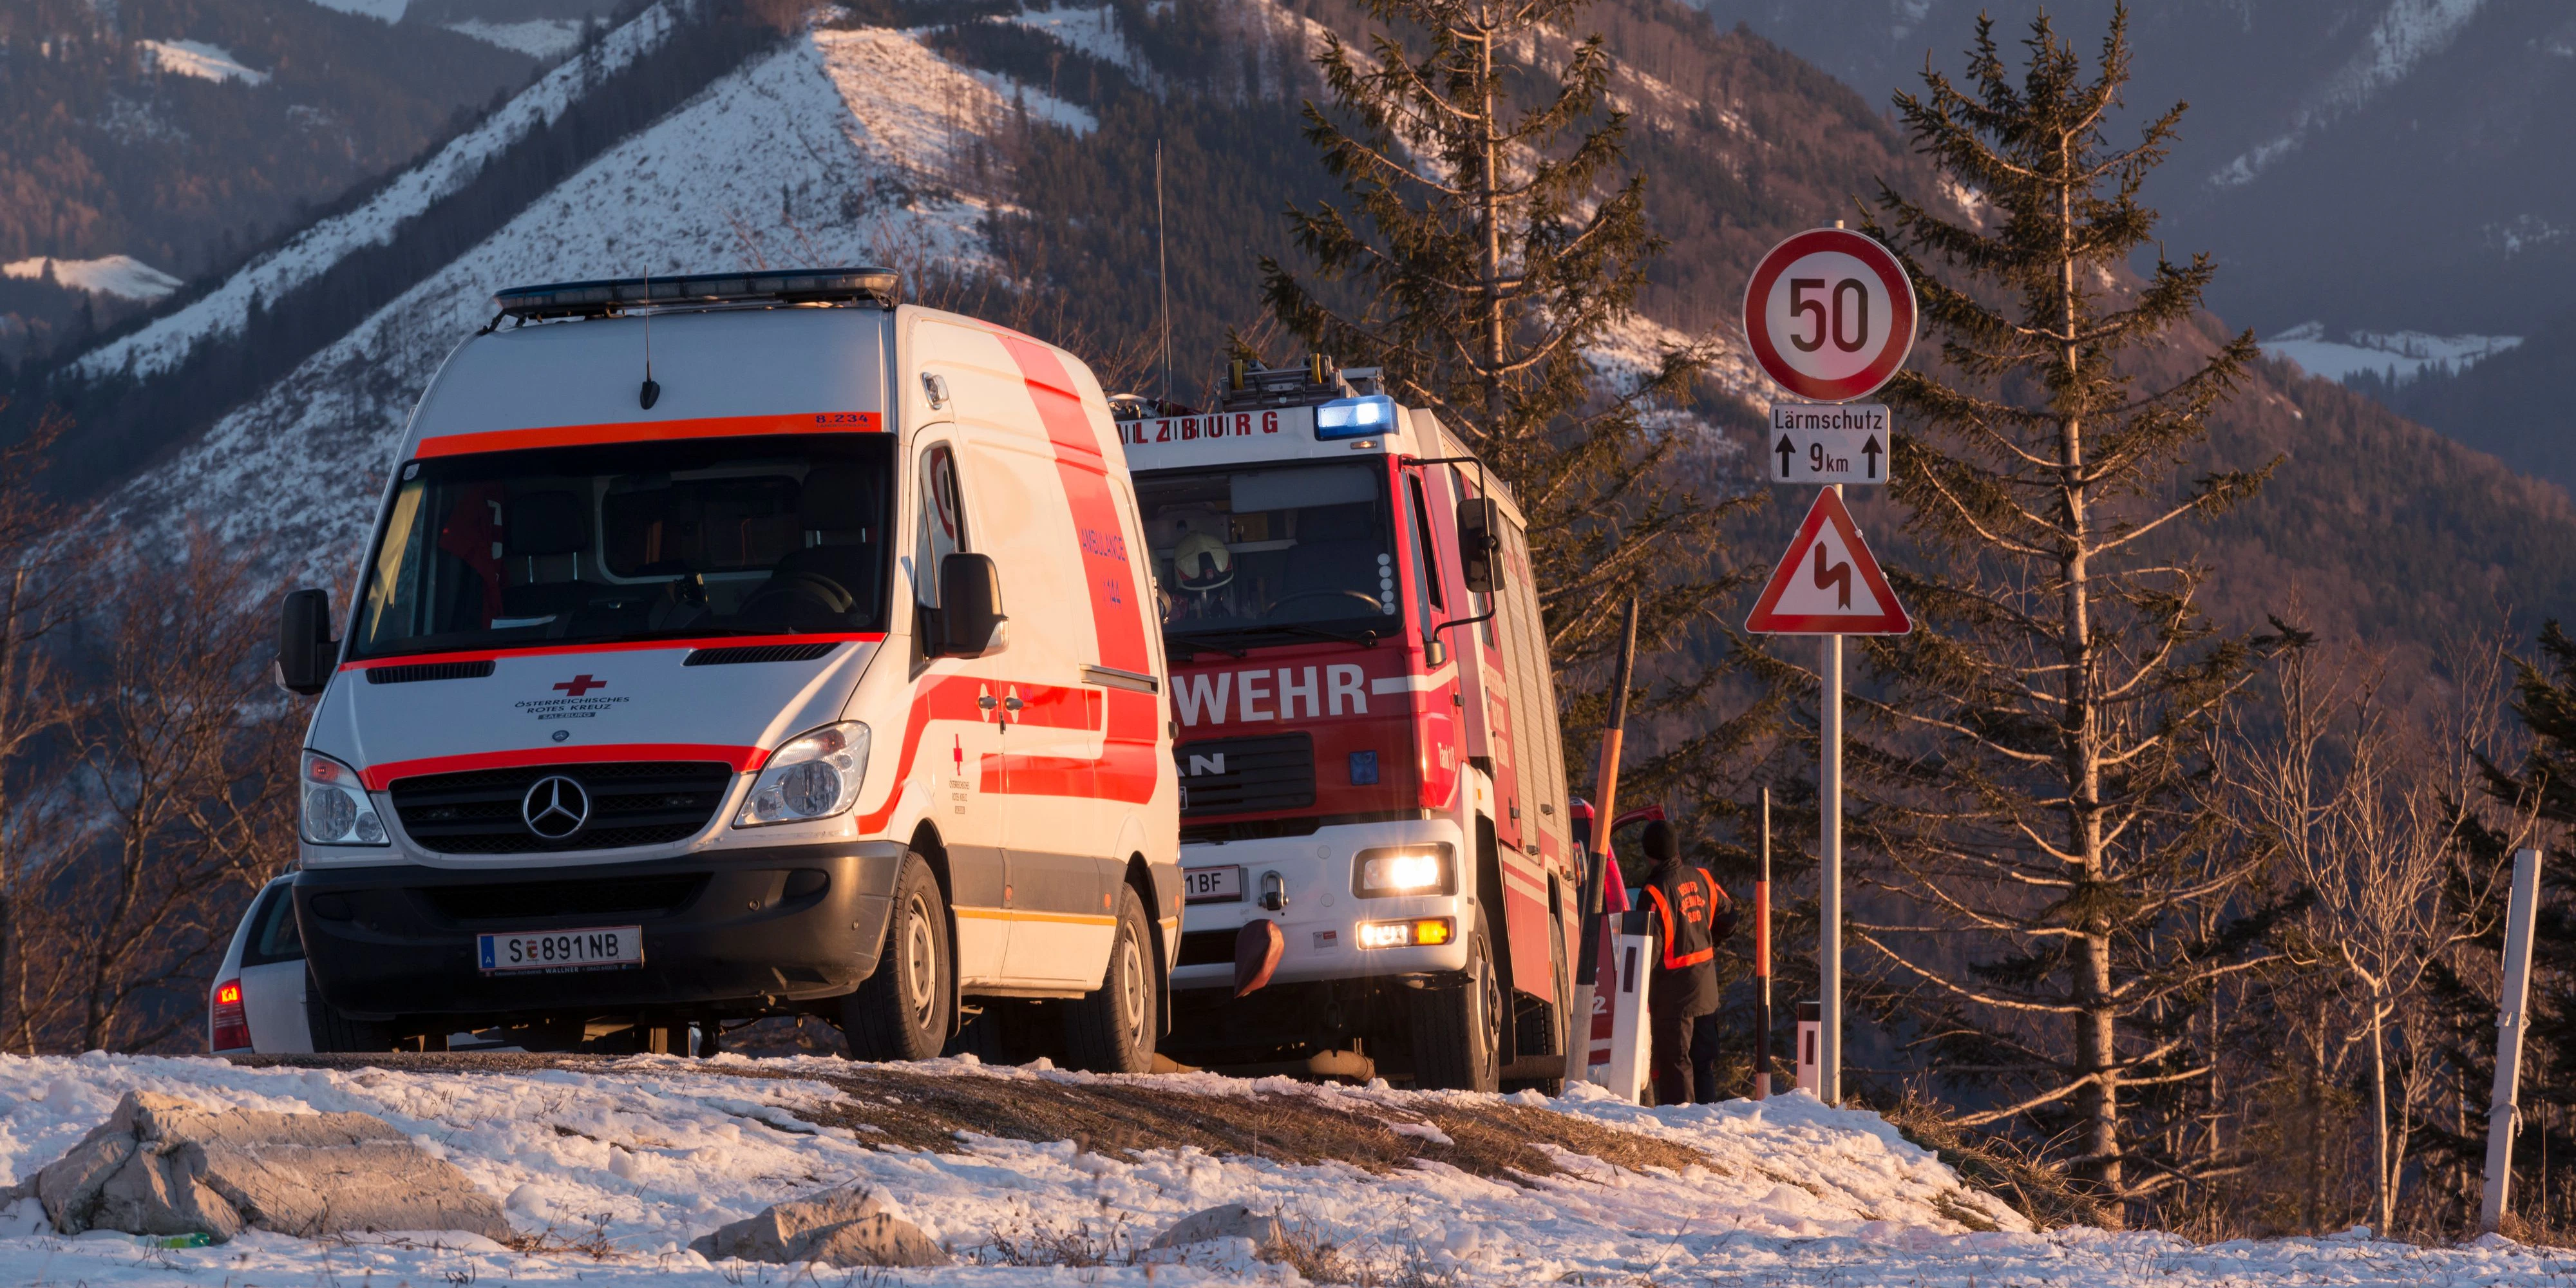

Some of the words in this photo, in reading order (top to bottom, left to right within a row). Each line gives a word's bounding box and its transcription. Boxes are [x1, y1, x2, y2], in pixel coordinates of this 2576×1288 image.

[1790, 278, 1868, 352] 50
[1775, 409, 1882, 430] Lärmschutz
[1081, 527, 1126, 562] AMBULANCE
[515, 697, 630, 708] ÖSTERREICHISCHES
[1171, 663, 1368, 726] WEHR
